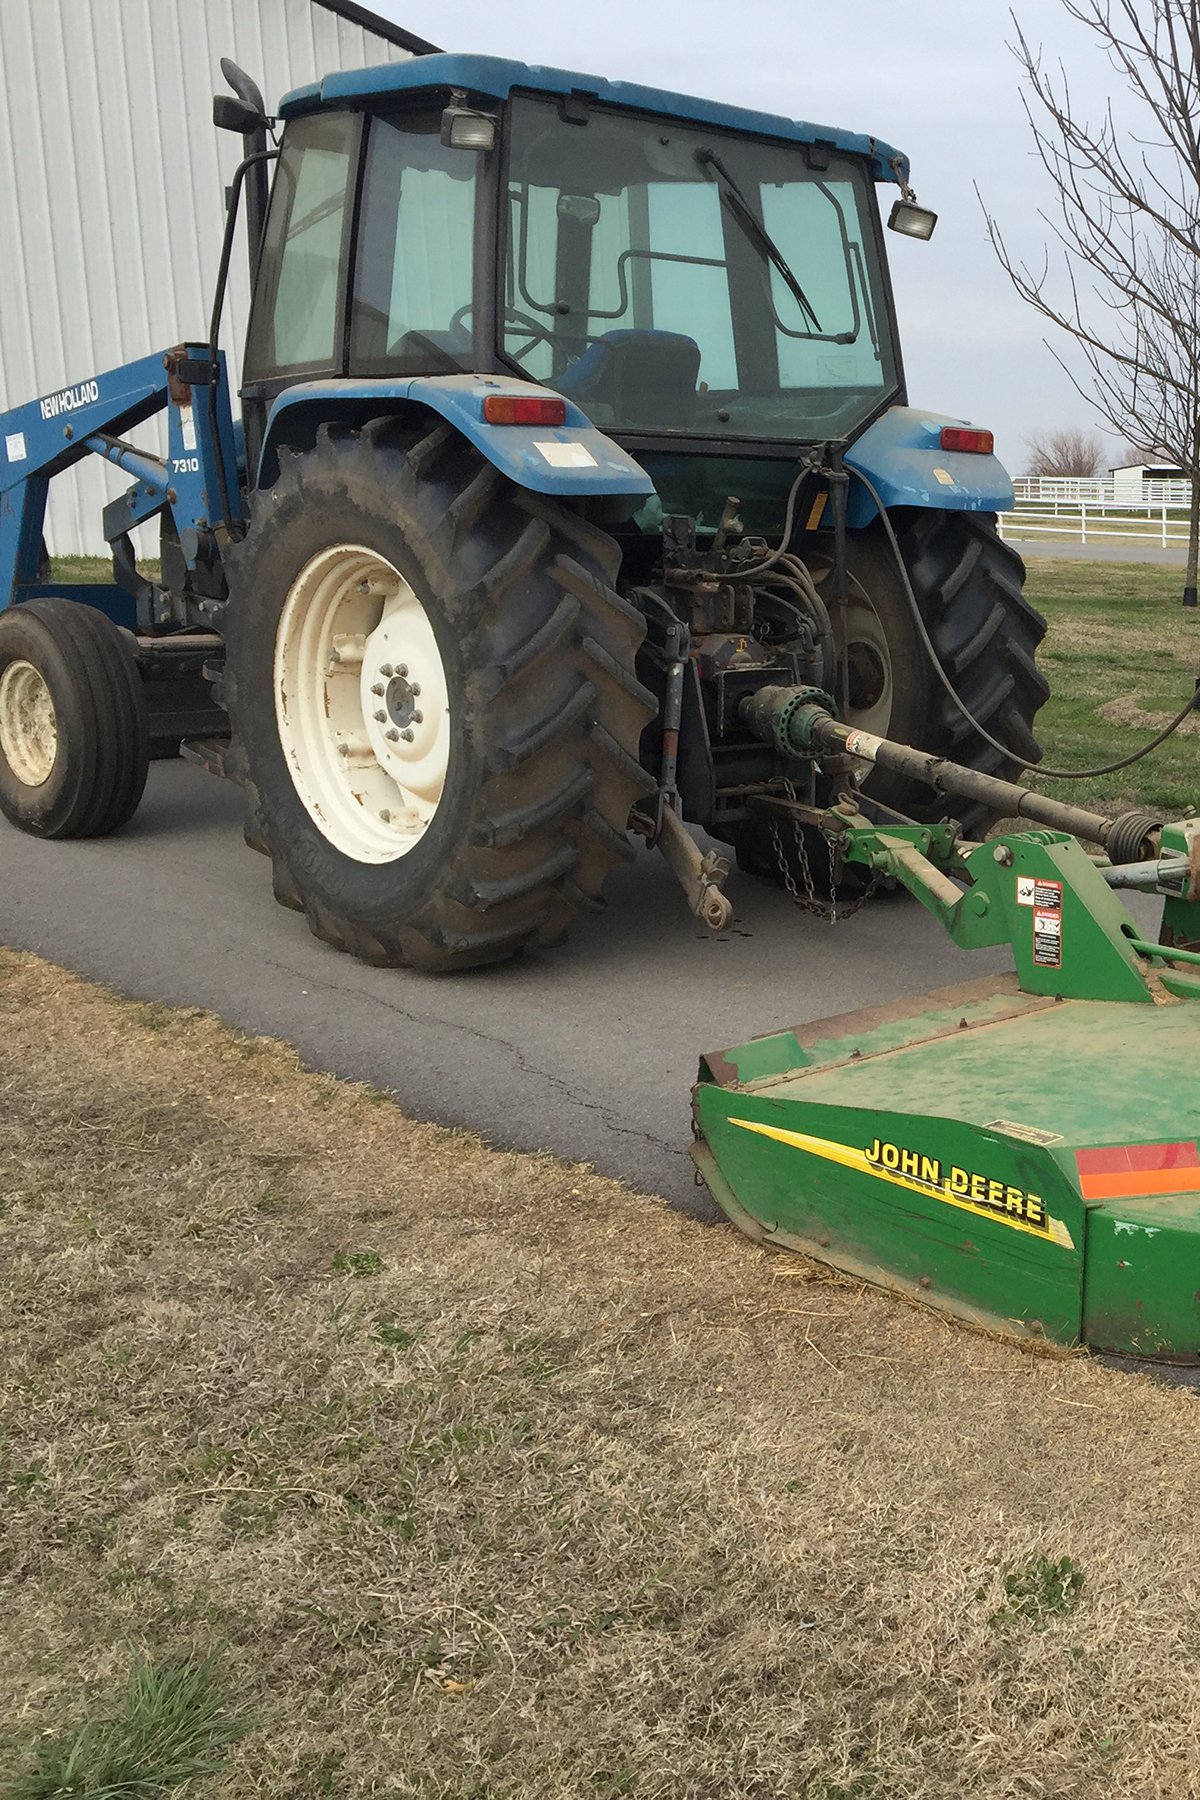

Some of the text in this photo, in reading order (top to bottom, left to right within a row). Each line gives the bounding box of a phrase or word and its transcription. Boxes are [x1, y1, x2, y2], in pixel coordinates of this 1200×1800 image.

[172, 457, 199, 473] 7310
[865, 1138, 1045, 1224] JOHN DEERE
